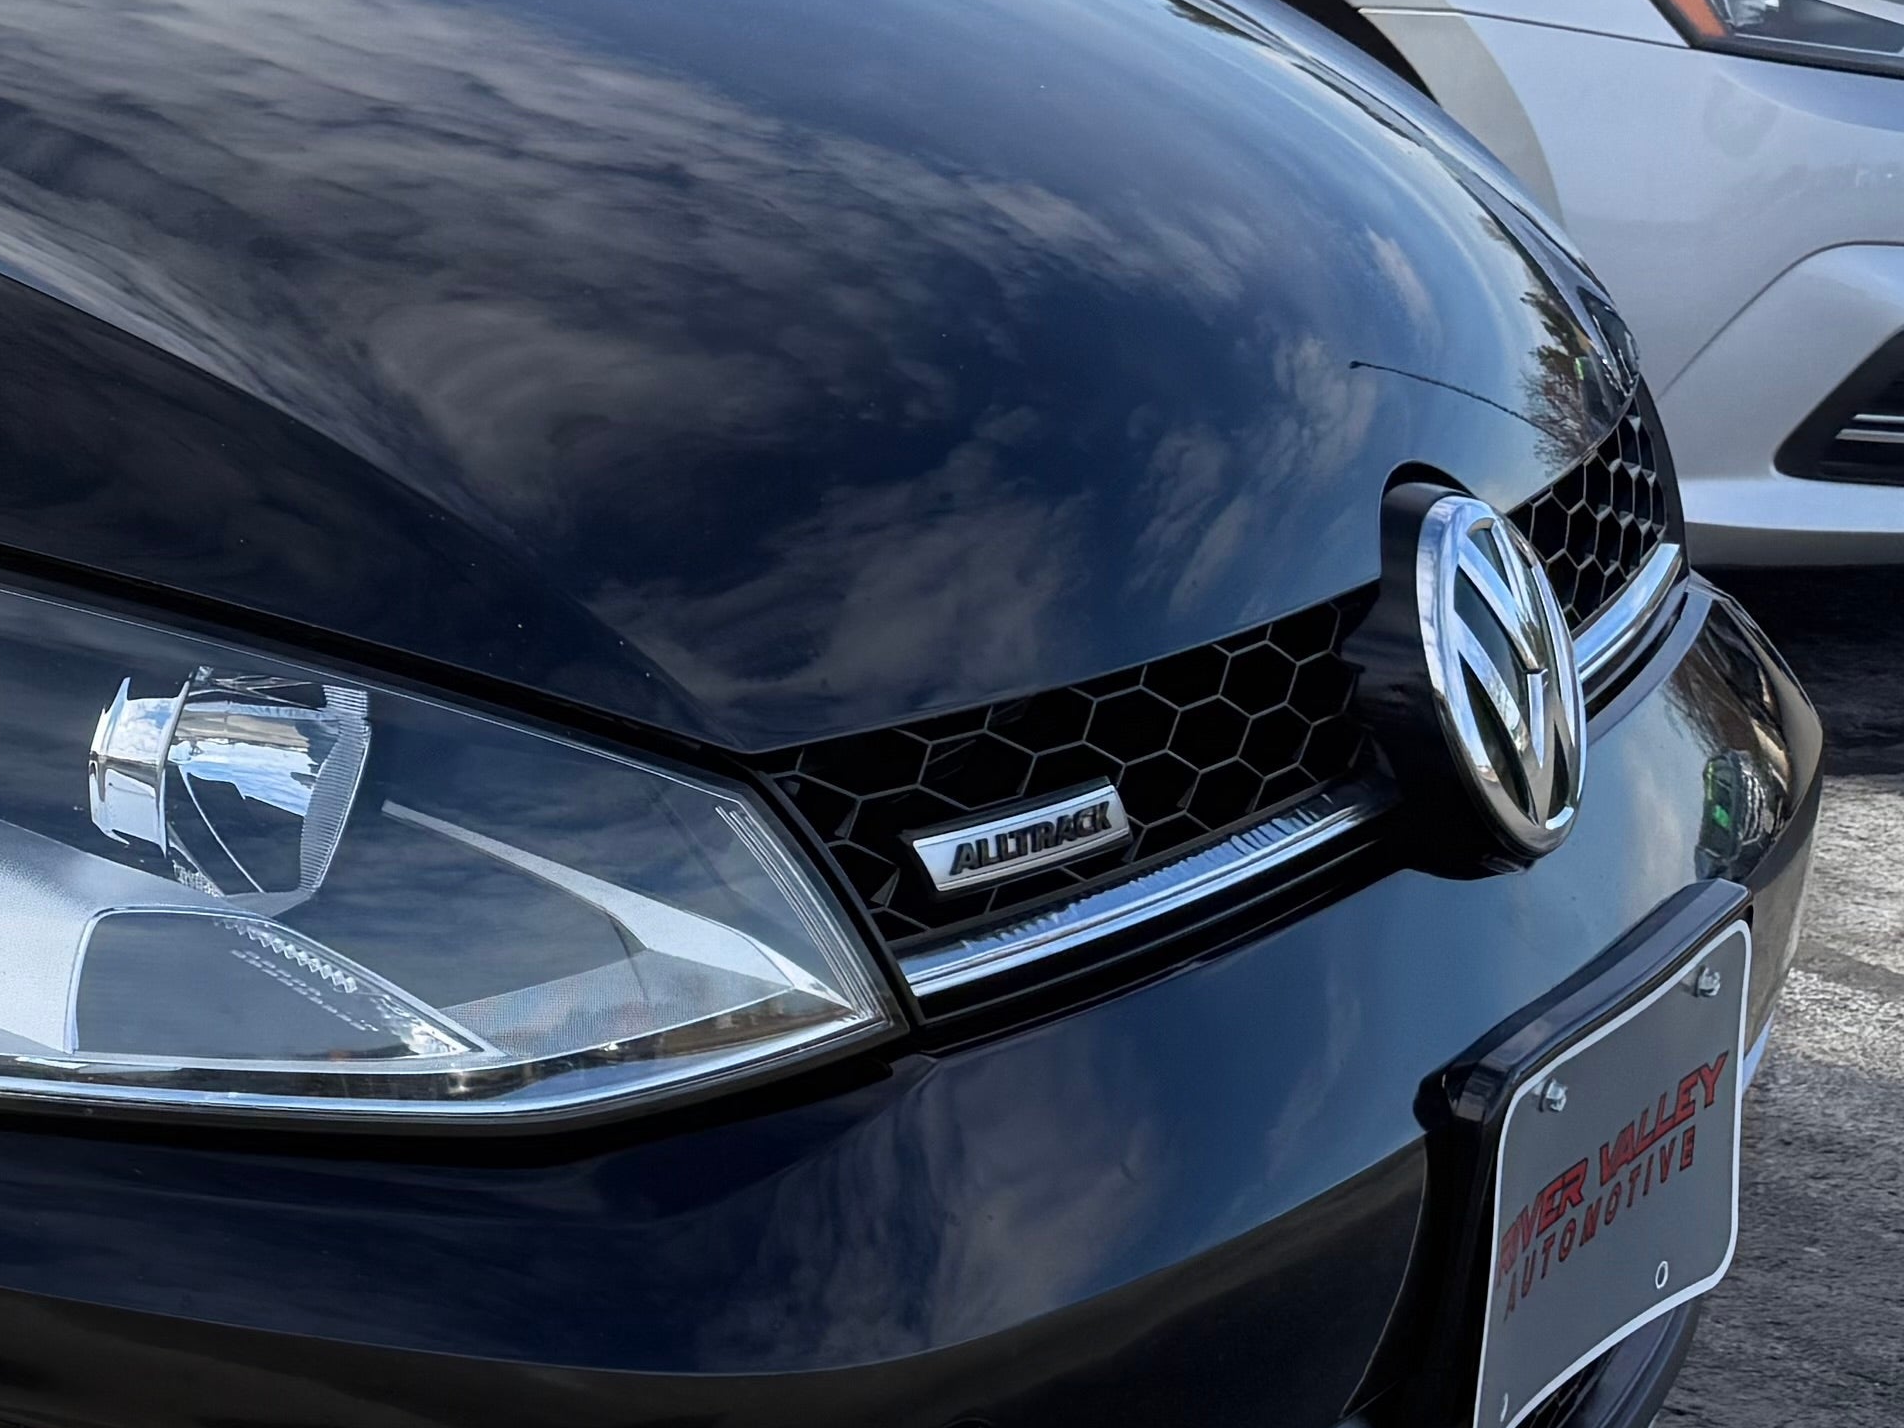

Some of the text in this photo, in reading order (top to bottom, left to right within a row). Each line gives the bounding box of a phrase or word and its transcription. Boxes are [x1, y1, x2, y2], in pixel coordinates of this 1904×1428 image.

[950, 799, 1114, 876] ALLTRACK
[1496, 1049, 1729, 1288] RIVER VALLEY
[1503, 1125, 1696, 1323] AUTOMOTIVE
